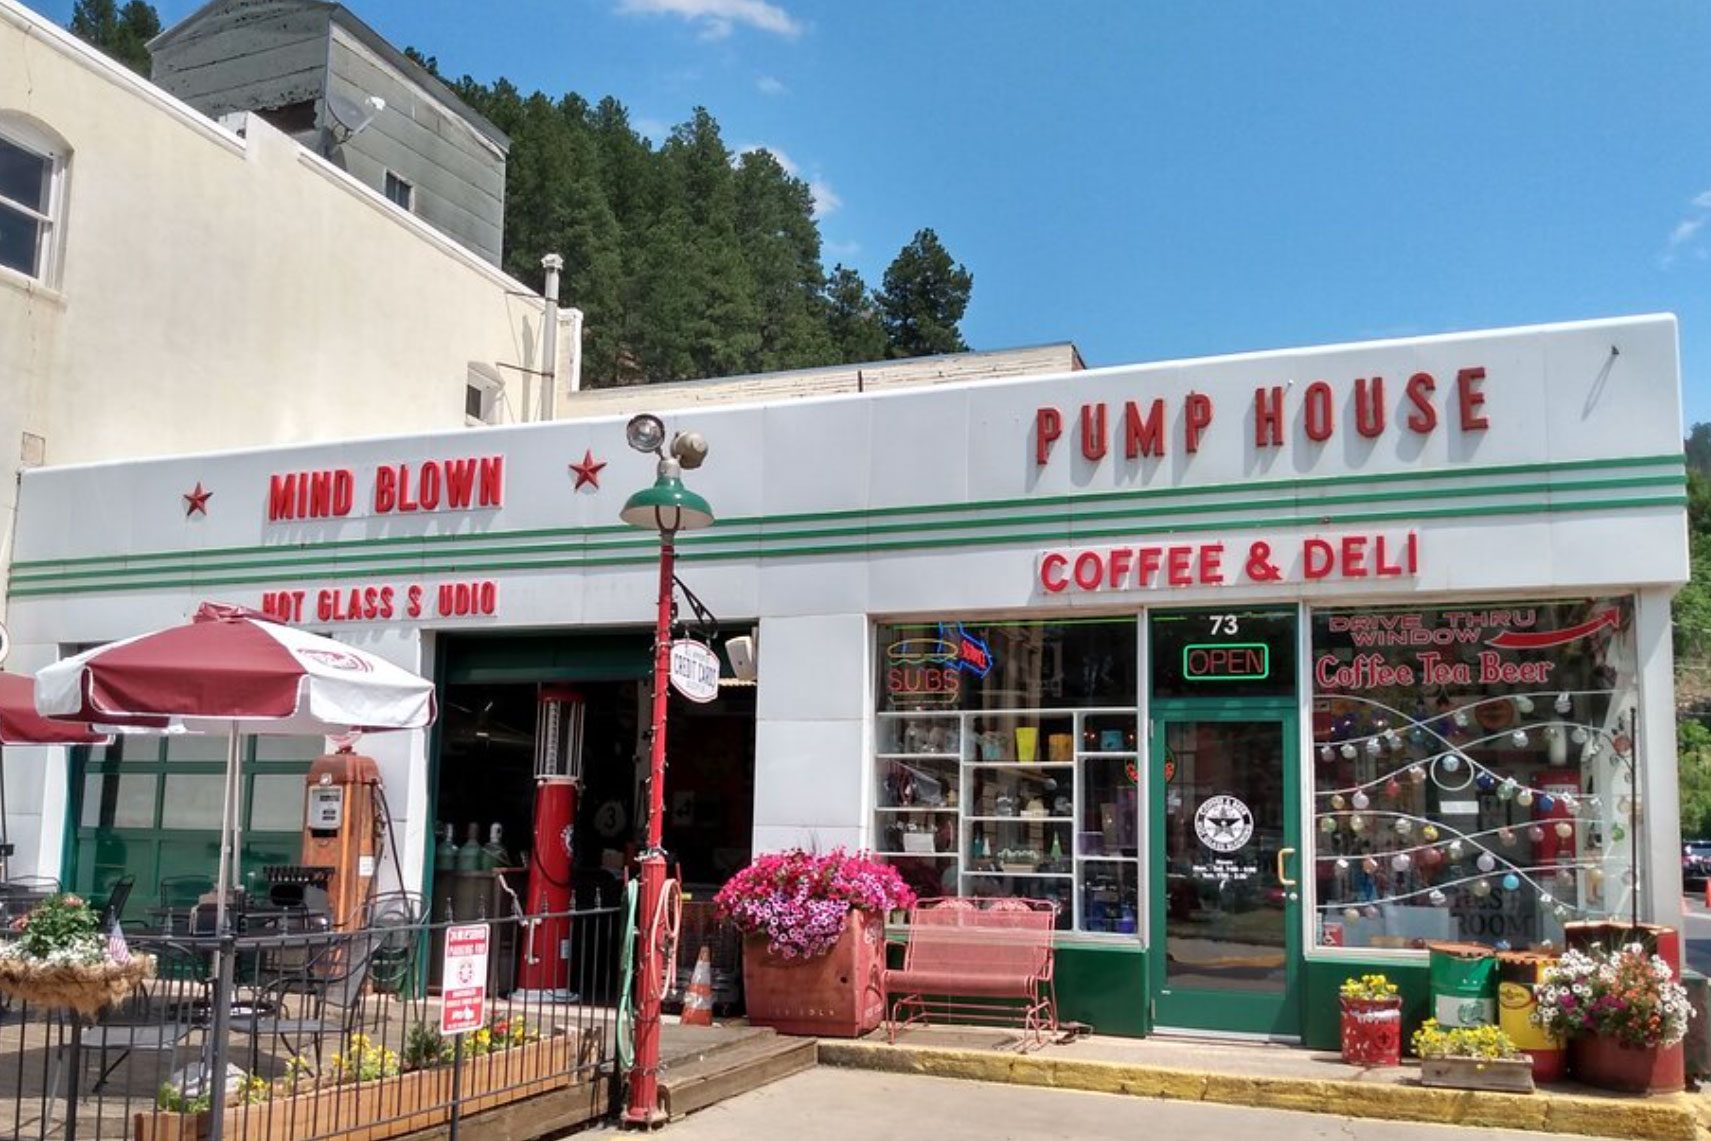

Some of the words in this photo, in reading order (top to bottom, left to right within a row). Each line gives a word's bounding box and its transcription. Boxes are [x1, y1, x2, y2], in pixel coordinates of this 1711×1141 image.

[1036, 391, 1213, 465] PUMP
[1254, 367, 1489, 448] HOUSE
[269, 469, 354, 522] MIND
[375, 456, 503, 514] BLOWN
[1040, 542, 1224, 591] COFFEE
[1246, 541, 1282, 581] &
[1304, 532, 1417, 579] DELI
[262, 590, 305, 622] HOT
[317, 586, 394, 622] GLASS
[1209, 614, 1239, 636] 73
[1329, 613, 1423, 632] DRIVE
[1442, 609, 1536, 628] THRU
[1351, 628, 1481, 647] WINDOW
[674, 653, 697, 681] CREDIT
[1189, 649, 1264, 675] OPEN
[1316, 653, 1414, 689] Coffee
[1416, 651, 1471, 686] Tea
[1478, 650, 1555, 685] Beer
[888, 667, 960, 692] SUBS
